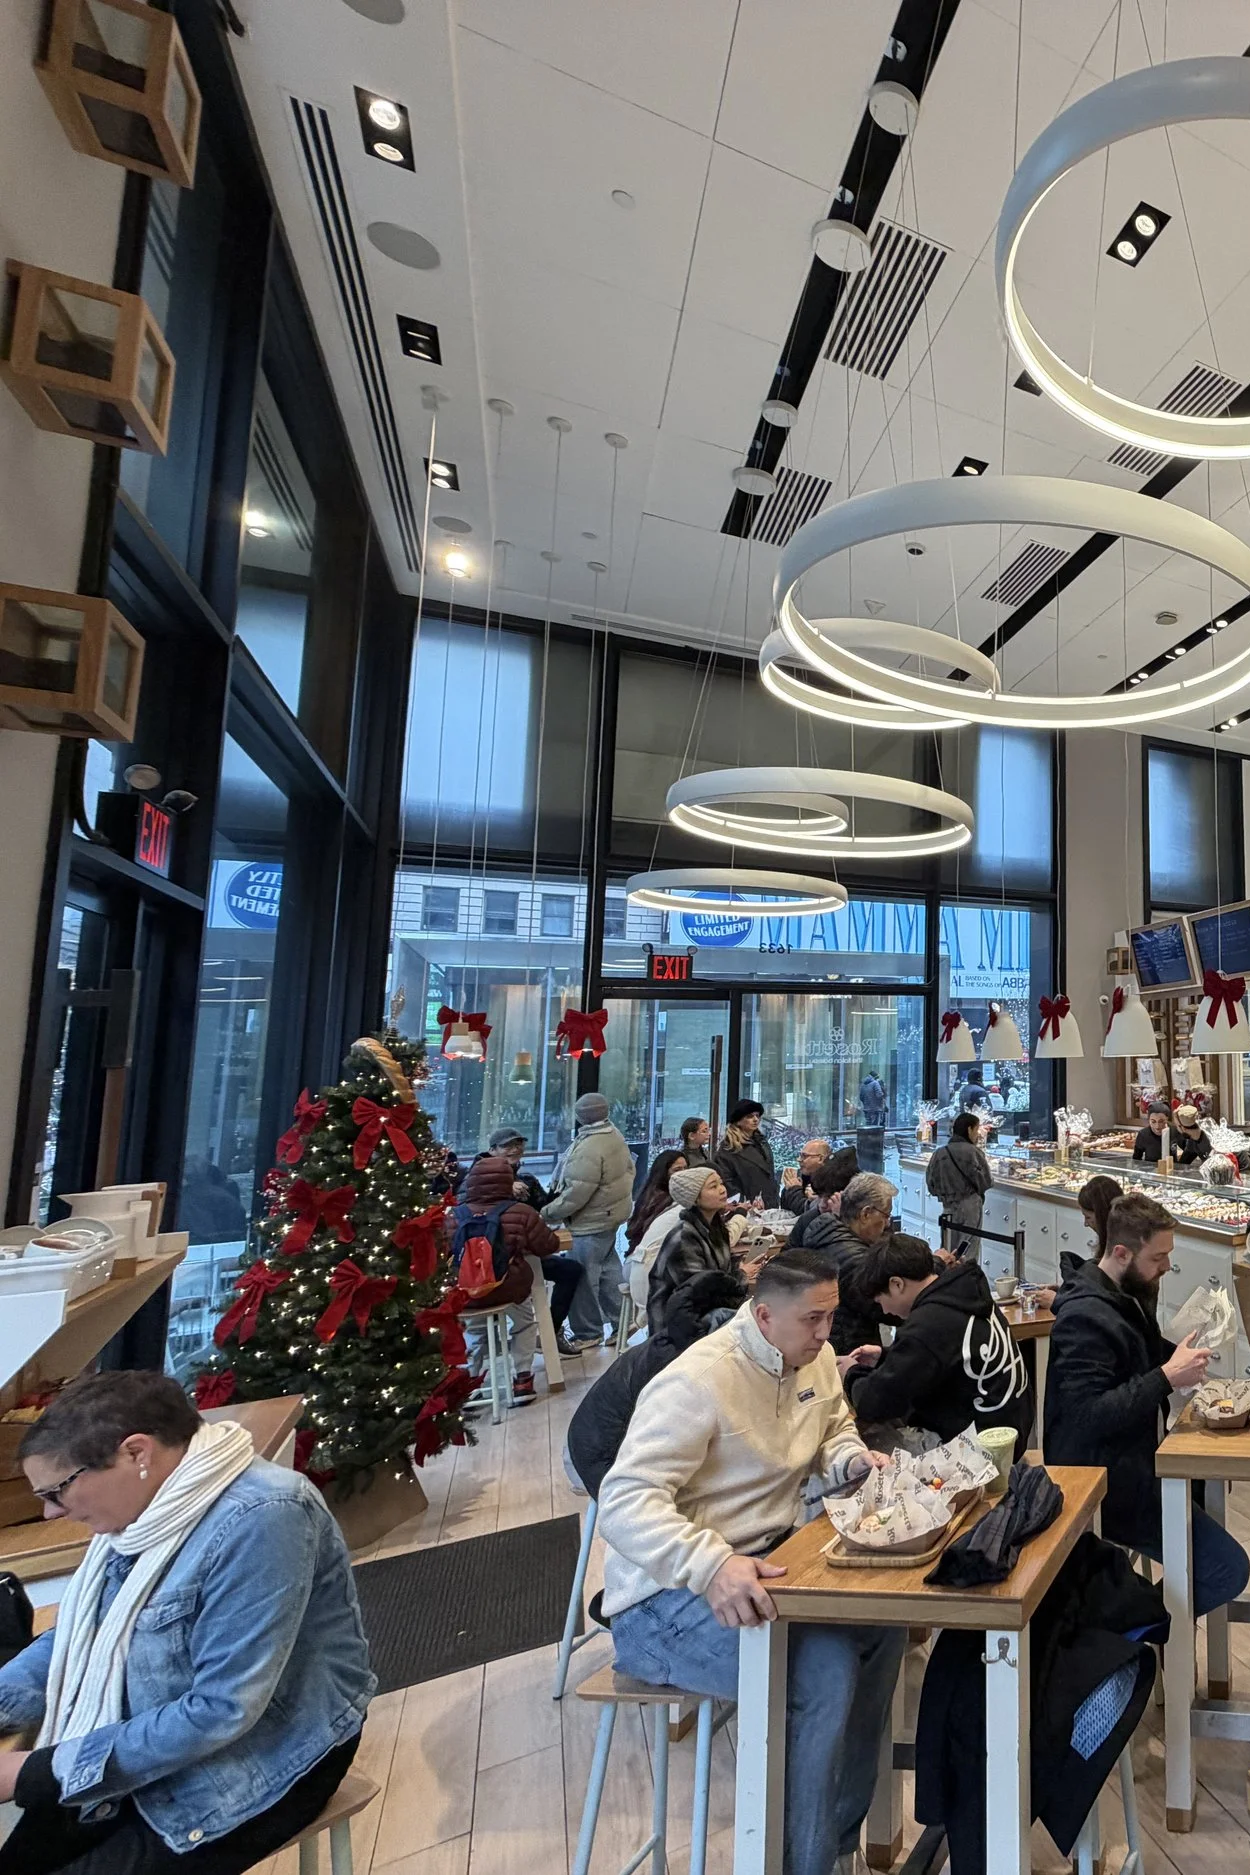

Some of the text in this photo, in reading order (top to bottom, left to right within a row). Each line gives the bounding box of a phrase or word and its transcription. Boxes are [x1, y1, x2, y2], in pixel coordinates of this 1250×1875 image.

[139, 802, 170, 870] EXIT
[688, 921, 751, 938] ENGAGEMENT
[653, 957, 690, 980] EXIT
